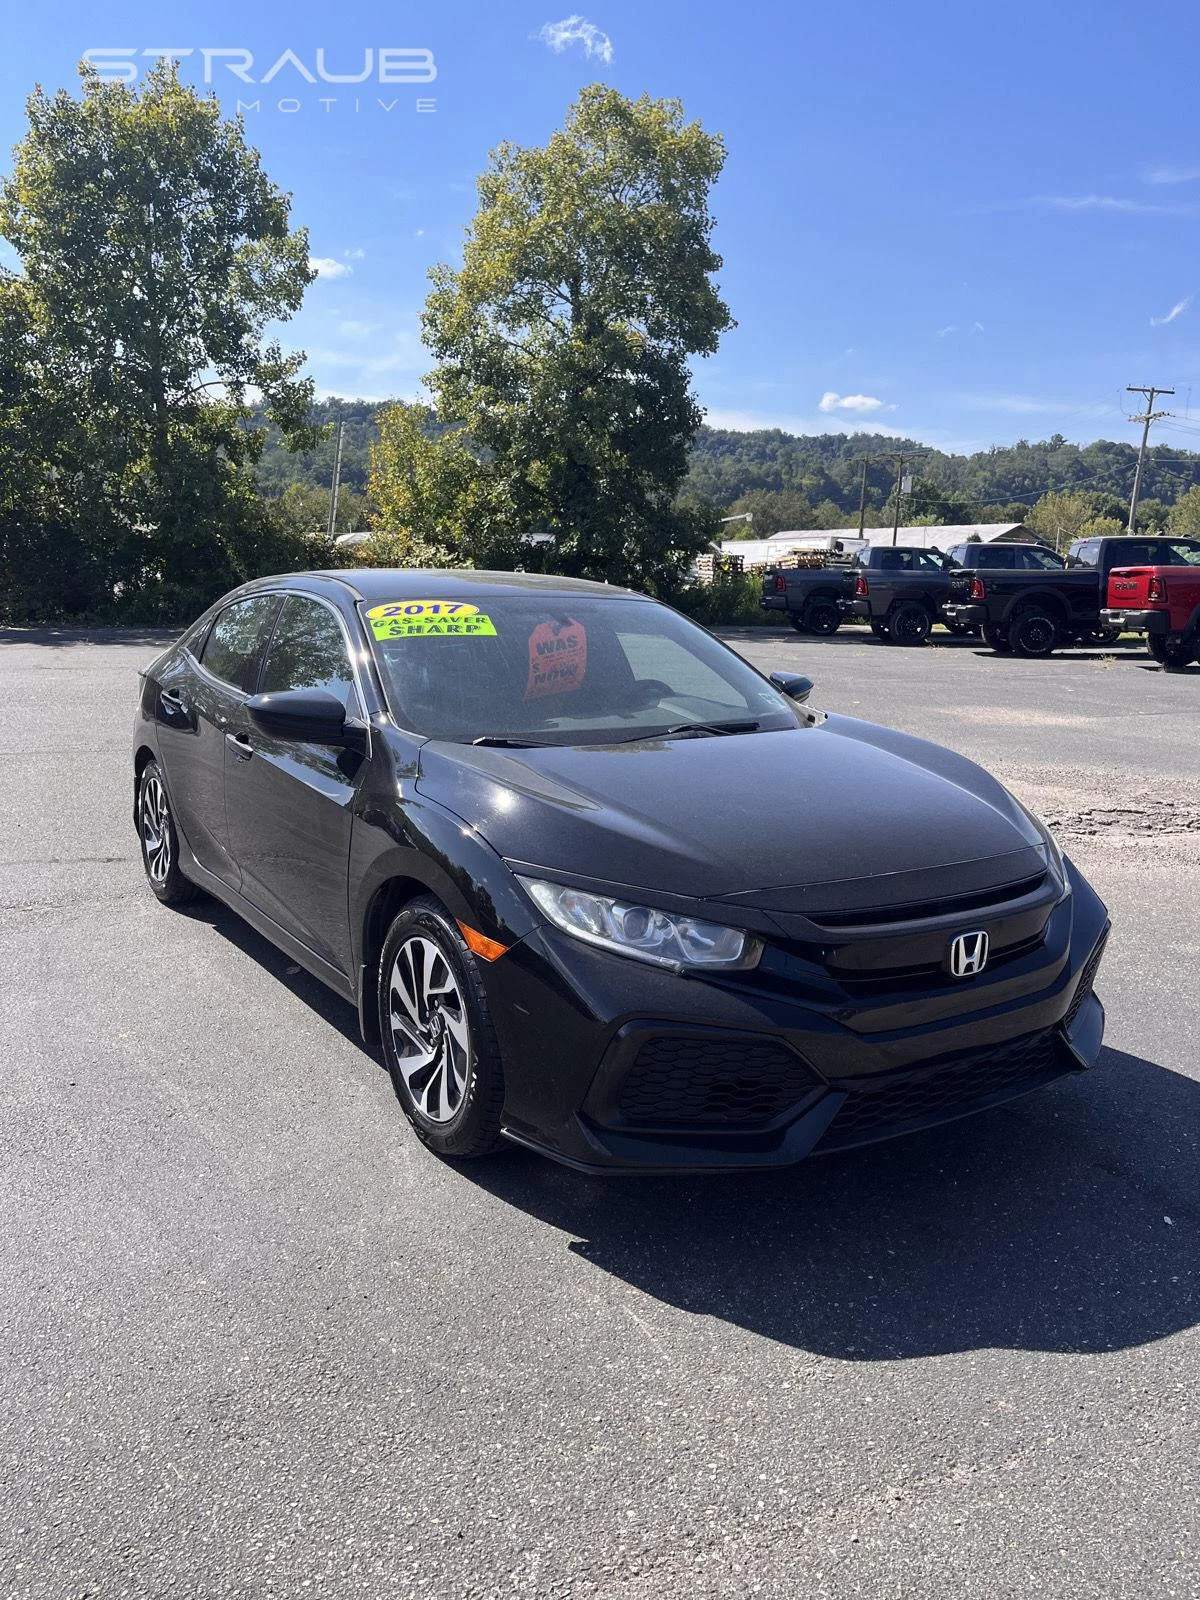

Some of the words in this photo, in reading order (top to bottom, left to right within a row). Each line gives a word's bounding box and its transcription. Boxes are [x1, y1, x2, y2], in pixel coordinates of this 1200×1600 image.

[1114, 582, 1138, 591] RAM
[381, 604, 464, 618] 2017
[373, 616, 487, 628] GAS-SAVER
[388, 624, 481, 636] SHARP
[536, 634, 578, 656] WAS
